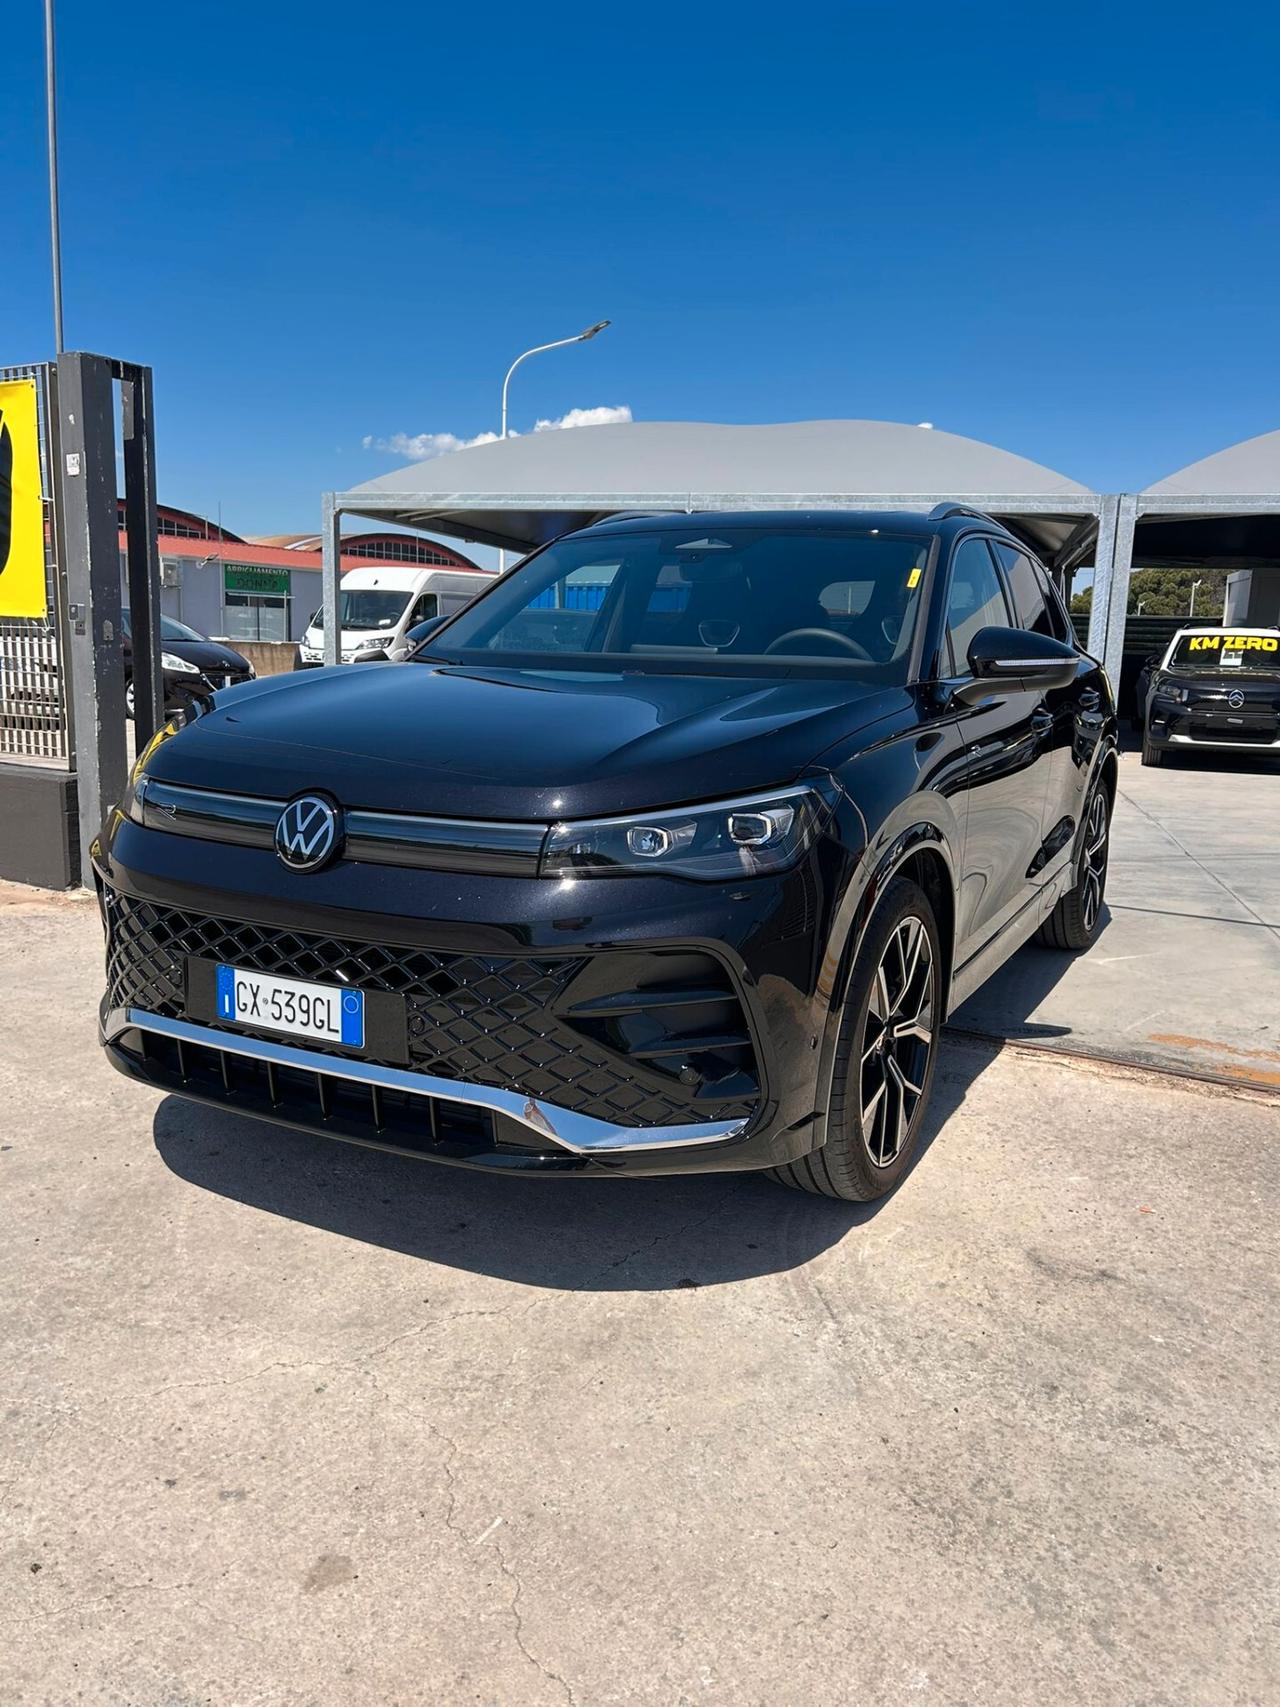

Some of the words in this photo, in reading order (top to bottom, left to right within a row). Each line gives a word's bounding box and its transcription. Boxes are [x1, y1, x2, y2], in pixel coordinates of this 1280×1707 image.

[1189, 636, 1220, 650] KM
[1223, 636, 1278, 651] ZERO
[236, 981, 262, 1018] GX
[270, 988, 340, 1034] 539GL
